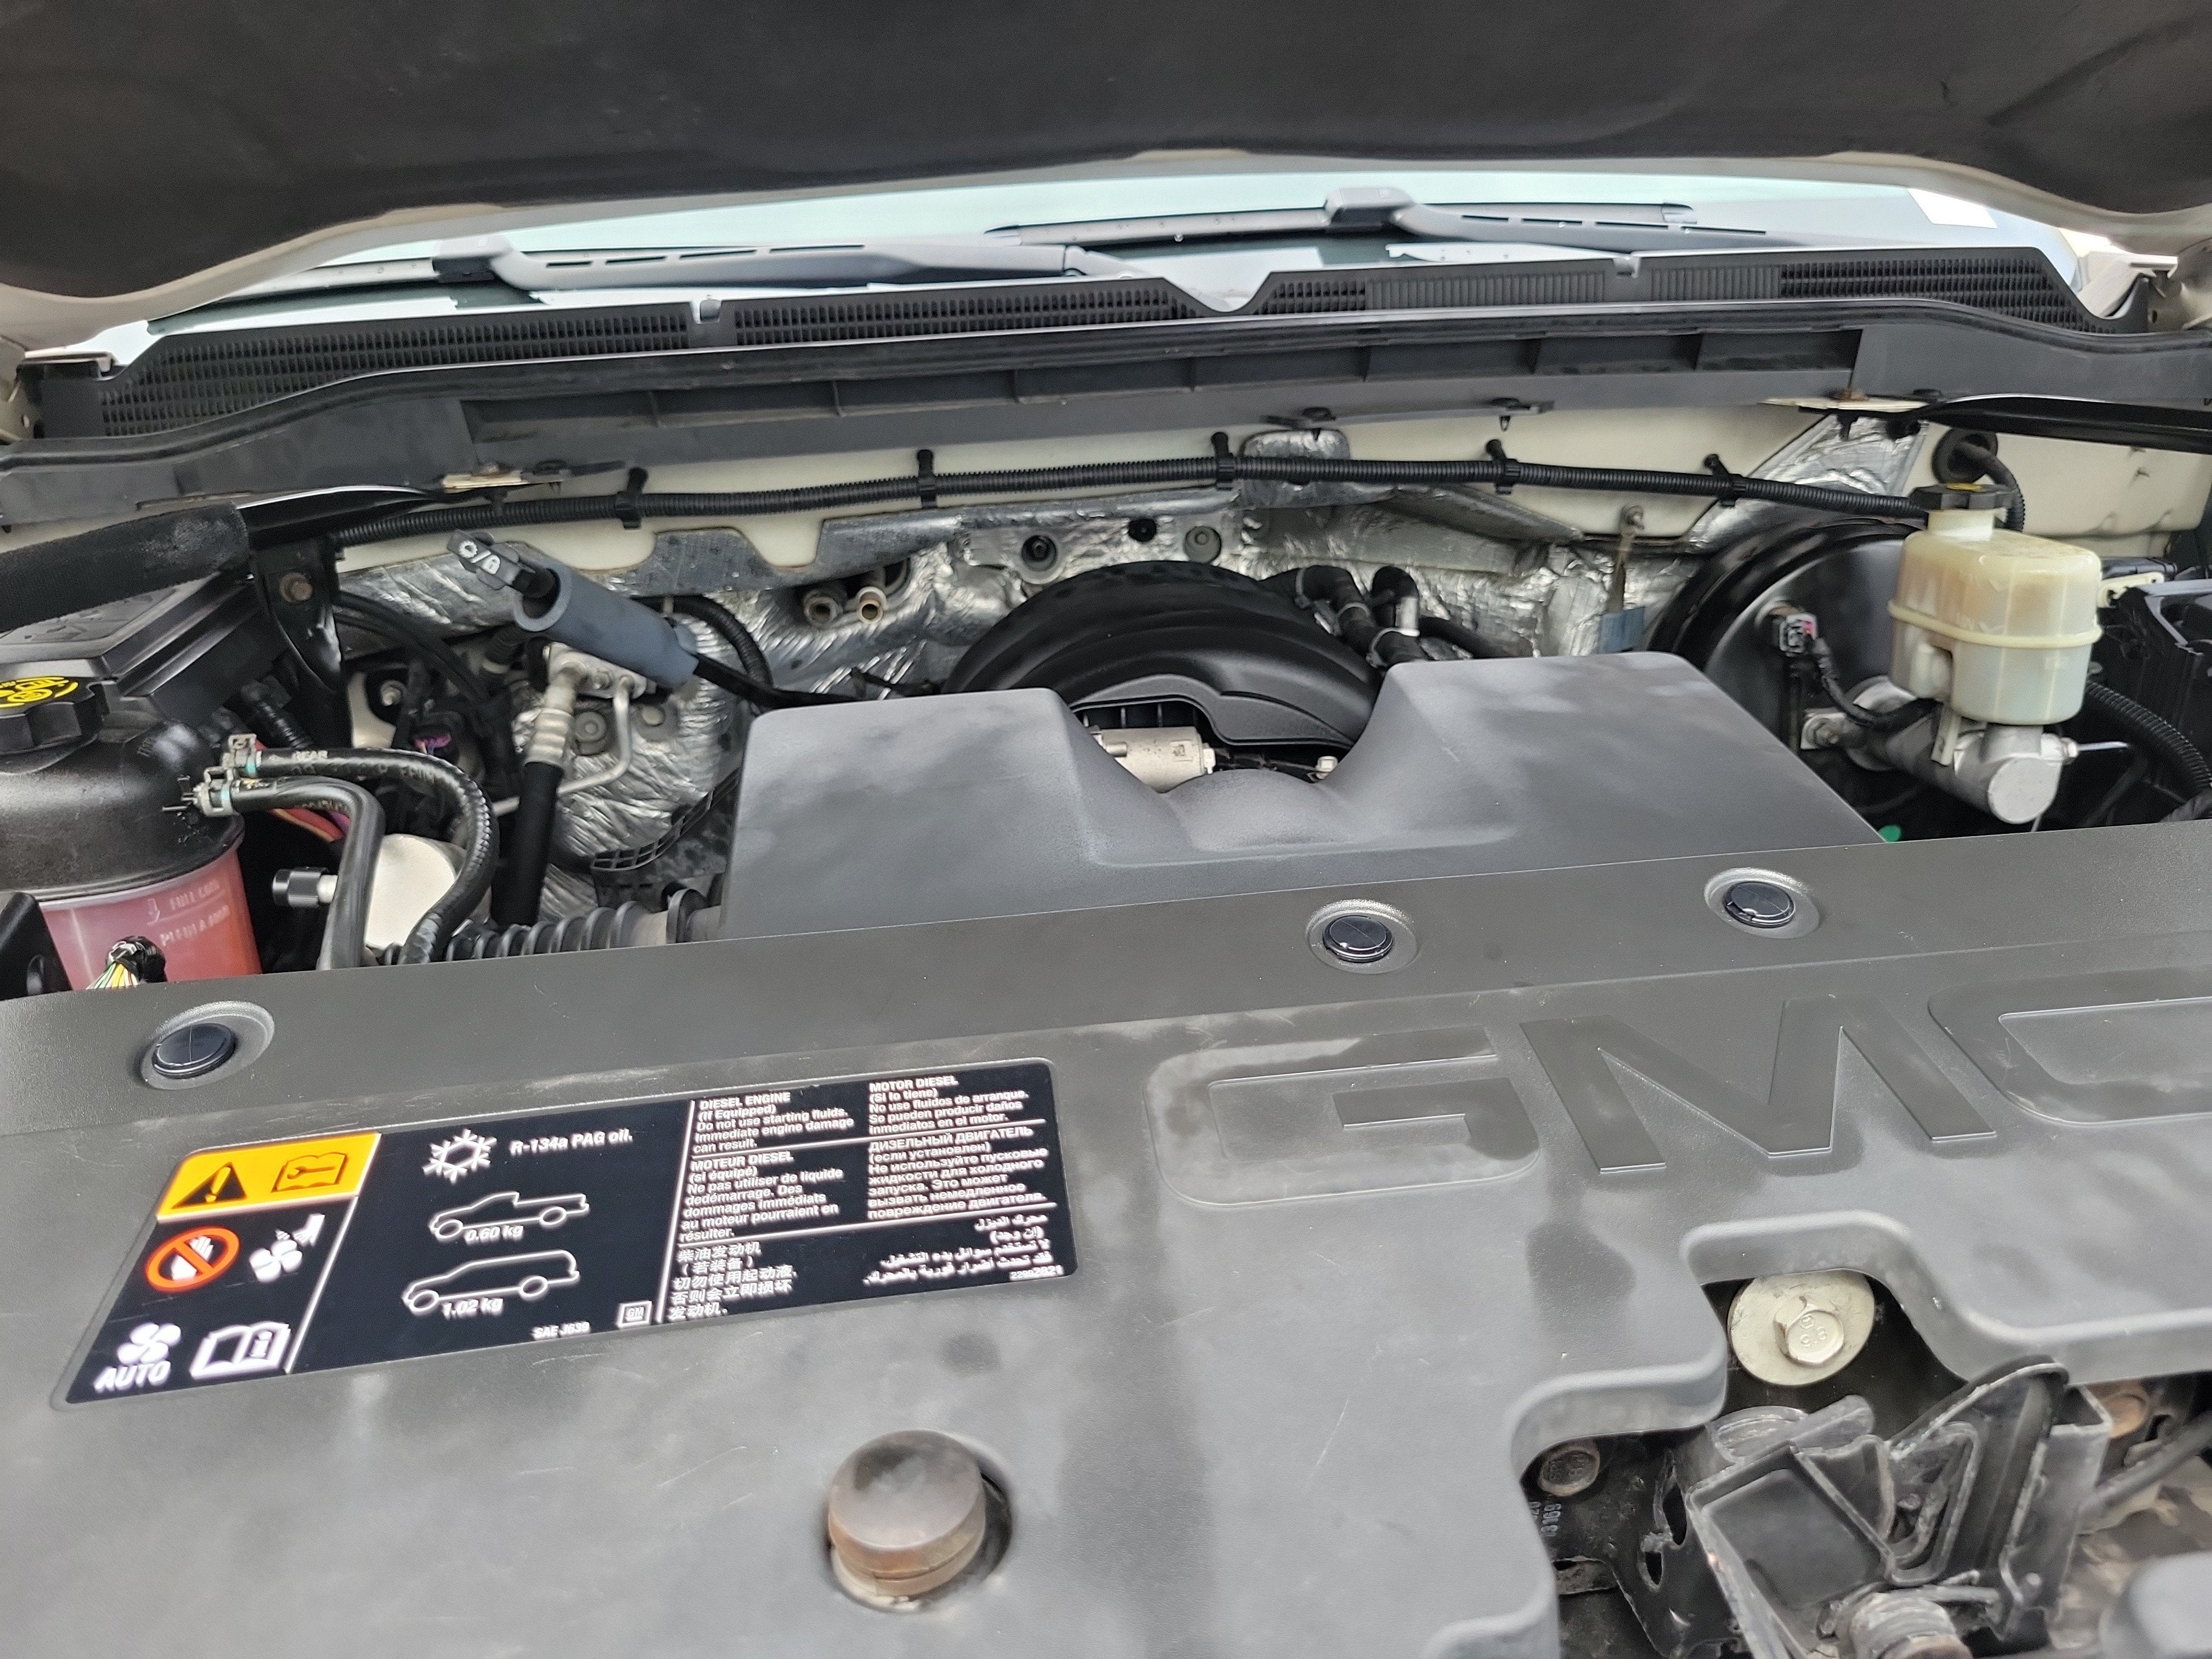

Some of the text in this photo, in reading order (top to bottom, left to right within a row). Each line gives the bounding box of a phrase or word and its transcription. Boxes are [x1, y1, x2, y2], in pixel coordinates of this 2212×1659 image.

[870, 1075, 958, 1092] MOTOR DIESEL
[700, 1092, 791, 1111] DIESEL ENGINE
[869, 1090, 1029, 1114] No use fluidos de arranque.
[870, 1087, 938, 1104] (Si lo tiene)
[697, 1107, 848, 1132] Do not use starting fluids.
[698, 1104, 777, 1122] (If Equipped)
[868, 1100, 1024, 1124] Se pueden producir daños
[695, 1118, 855, 1144] Immediate engine damage
[868, 1113, 1009, 1135] inmediatos en el motor.
[511, 1128, 633, 1156] R-134a PAG oil.
[693, 1138, 758, 1154] can result.
[868, 1126, 1034, 1153] ДИЗЕЛЬНЫЙ ДВИГАТЕЛЬ
[691, 1151, 794, 1172] MOTEUR DIESEL
[868, 1147, 1049, 1175] Не используйте пусковые
[869, 1141, 992, 1164] (если установлен)
[687, 1168, 844, 1195] Ne pas utiliser de liquide
[689, 1166, 758, 1183] (si équipé)
[868, 1159, 1045, 1185] жидкости для холодного
[777, 1184, 803, 1196] Des
[868, 1173, 1008, 1196] запуска. Это может
[868, 1183, 1026, 1208] вызвать немедленное
[684, 1193, 827, 1218] dommages immédiats
[868, 1192, 1047, 1220] повреждение двигателя.
[681, 1204, 840, 1231] au moteur pourraient en
[464, 1224, 524, 1244] 0.60 kg
[680, 1228, 735, 1242] résulter.
[678, 1242, 762, 1262] 柴油发动机
[671, 1279, 793, 1305] 否则会立即损坏
[443, 1297, 504, 1319] 1.02 kg
[532, 1321, 590, 1340] SAE J639
[93, 1360, 172, 1393] AUTO
